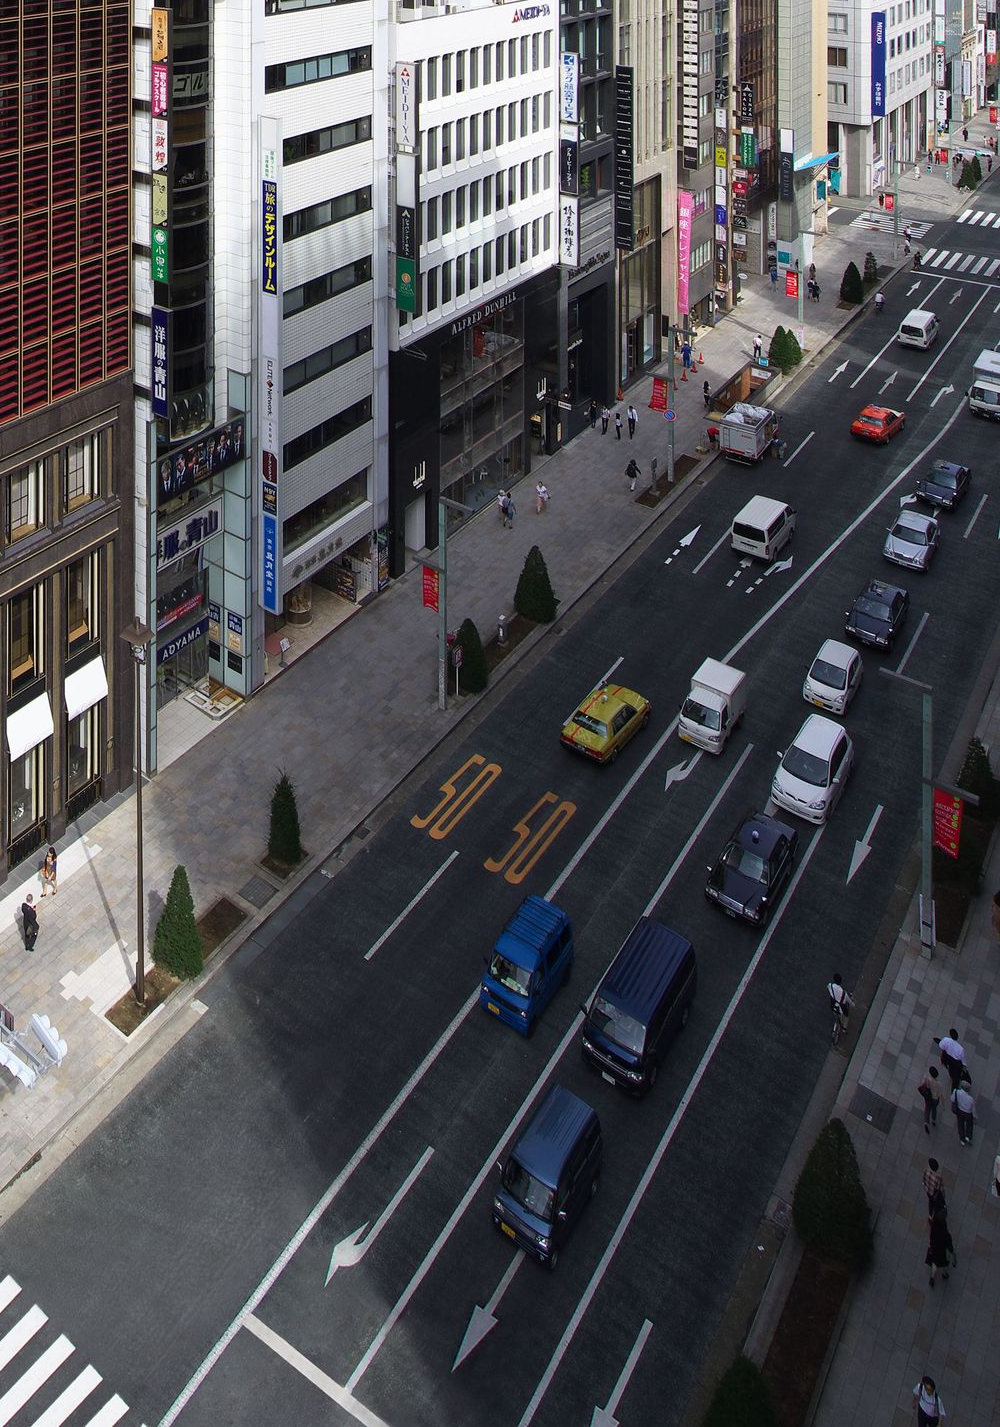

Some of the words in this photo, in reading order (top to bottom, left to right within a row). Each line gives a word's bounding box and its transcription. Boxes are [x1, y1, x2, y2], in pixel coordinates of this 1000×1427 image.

[451, 311, 482, 335] ALFRED
[484, 292, 518, 317] DUNHILL
[153, 325, 168, 402] 洋服の青山
[161, 626, 202, 662] AOYAMA
[409, 751, 503, 840] 50
[483, 790, 578, 886] 50
